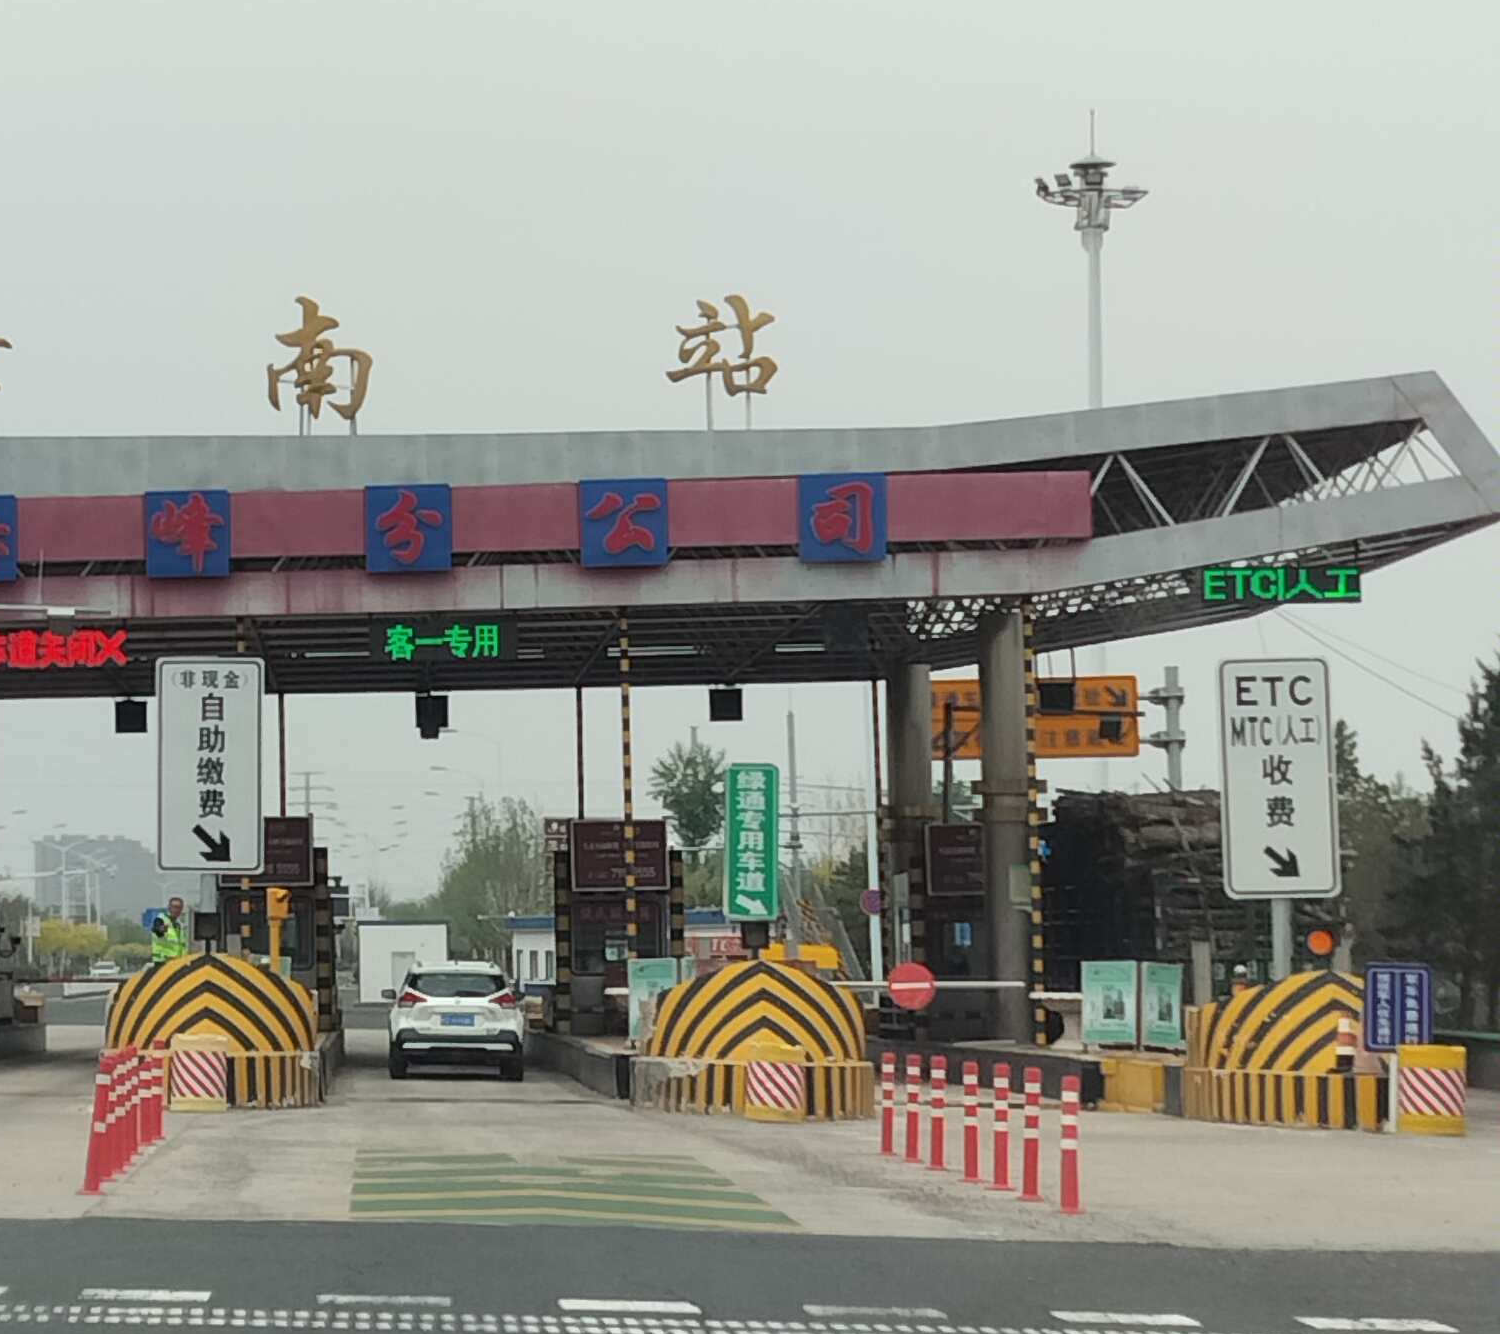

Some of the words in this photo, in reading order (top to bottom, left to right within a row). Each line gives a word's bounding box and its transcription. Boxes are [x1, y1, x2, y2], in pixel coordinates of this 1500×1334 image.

[385, 624, 499, 661] 客一专用
[1235, 675, 1313, 706] ETC
[196, 693, 226, 818] 自助缴费
[1262, 754, 1295, 828] 收费
[735, 770, 766, 892] 绿通专用车道
